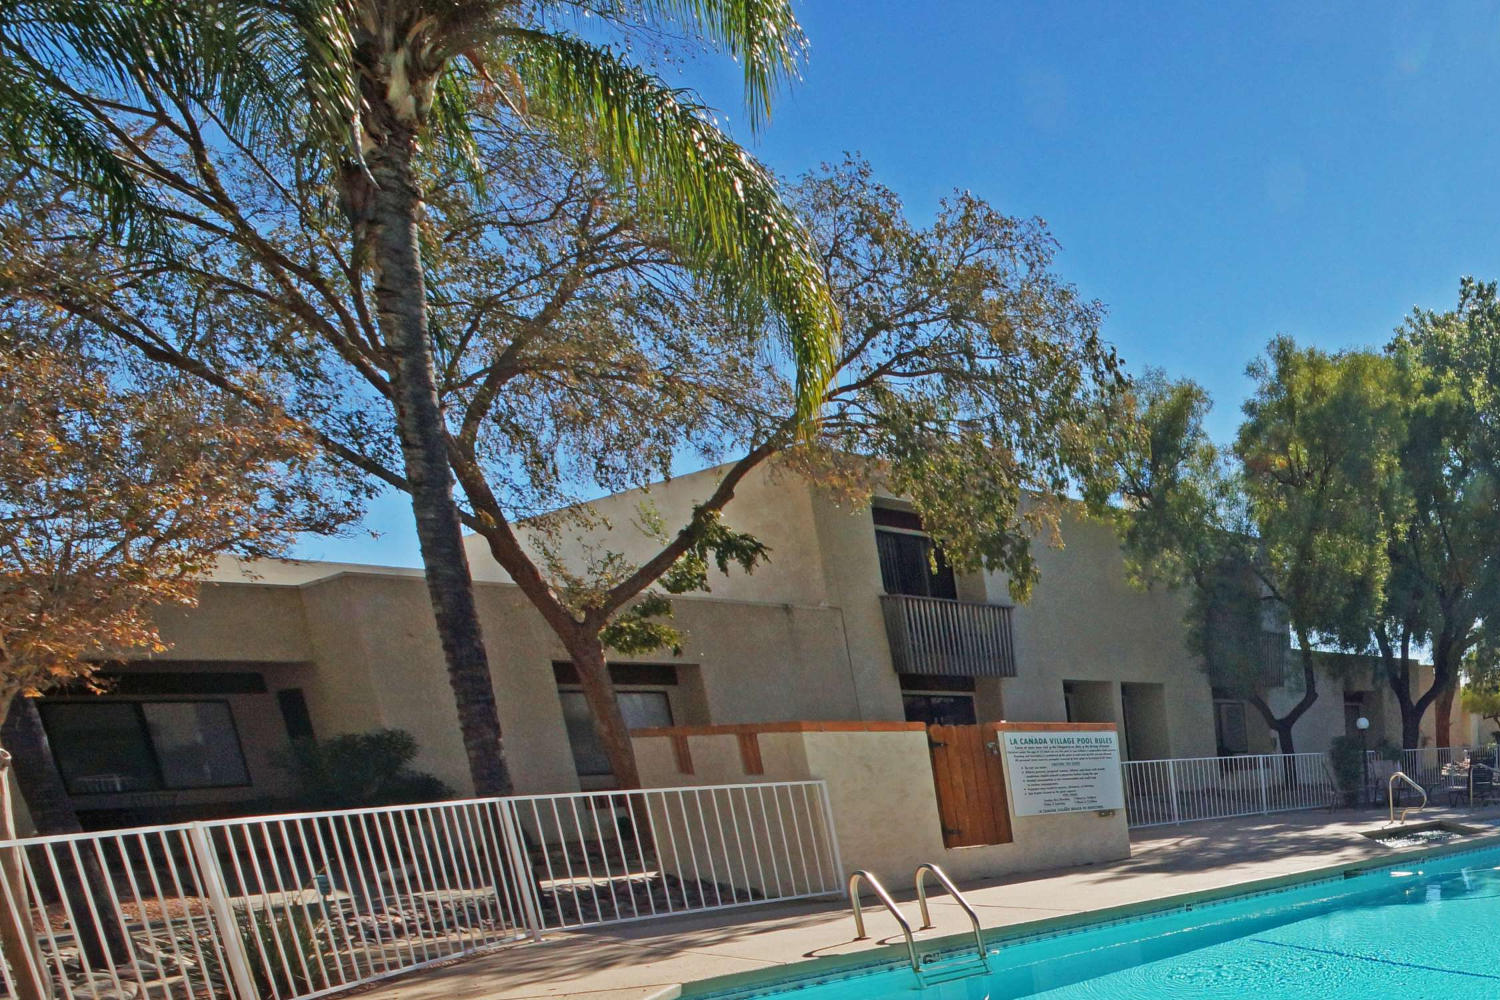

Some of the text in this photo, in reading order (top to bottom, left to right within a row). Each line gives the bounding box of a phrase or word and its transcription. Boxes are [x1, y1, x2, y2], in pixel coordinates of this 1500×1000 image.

[1010, 737, 1018, 745] LA
[1050, 737, 1075, 745] VILLAGE
[1077, 737, 1093, 745] POOL
